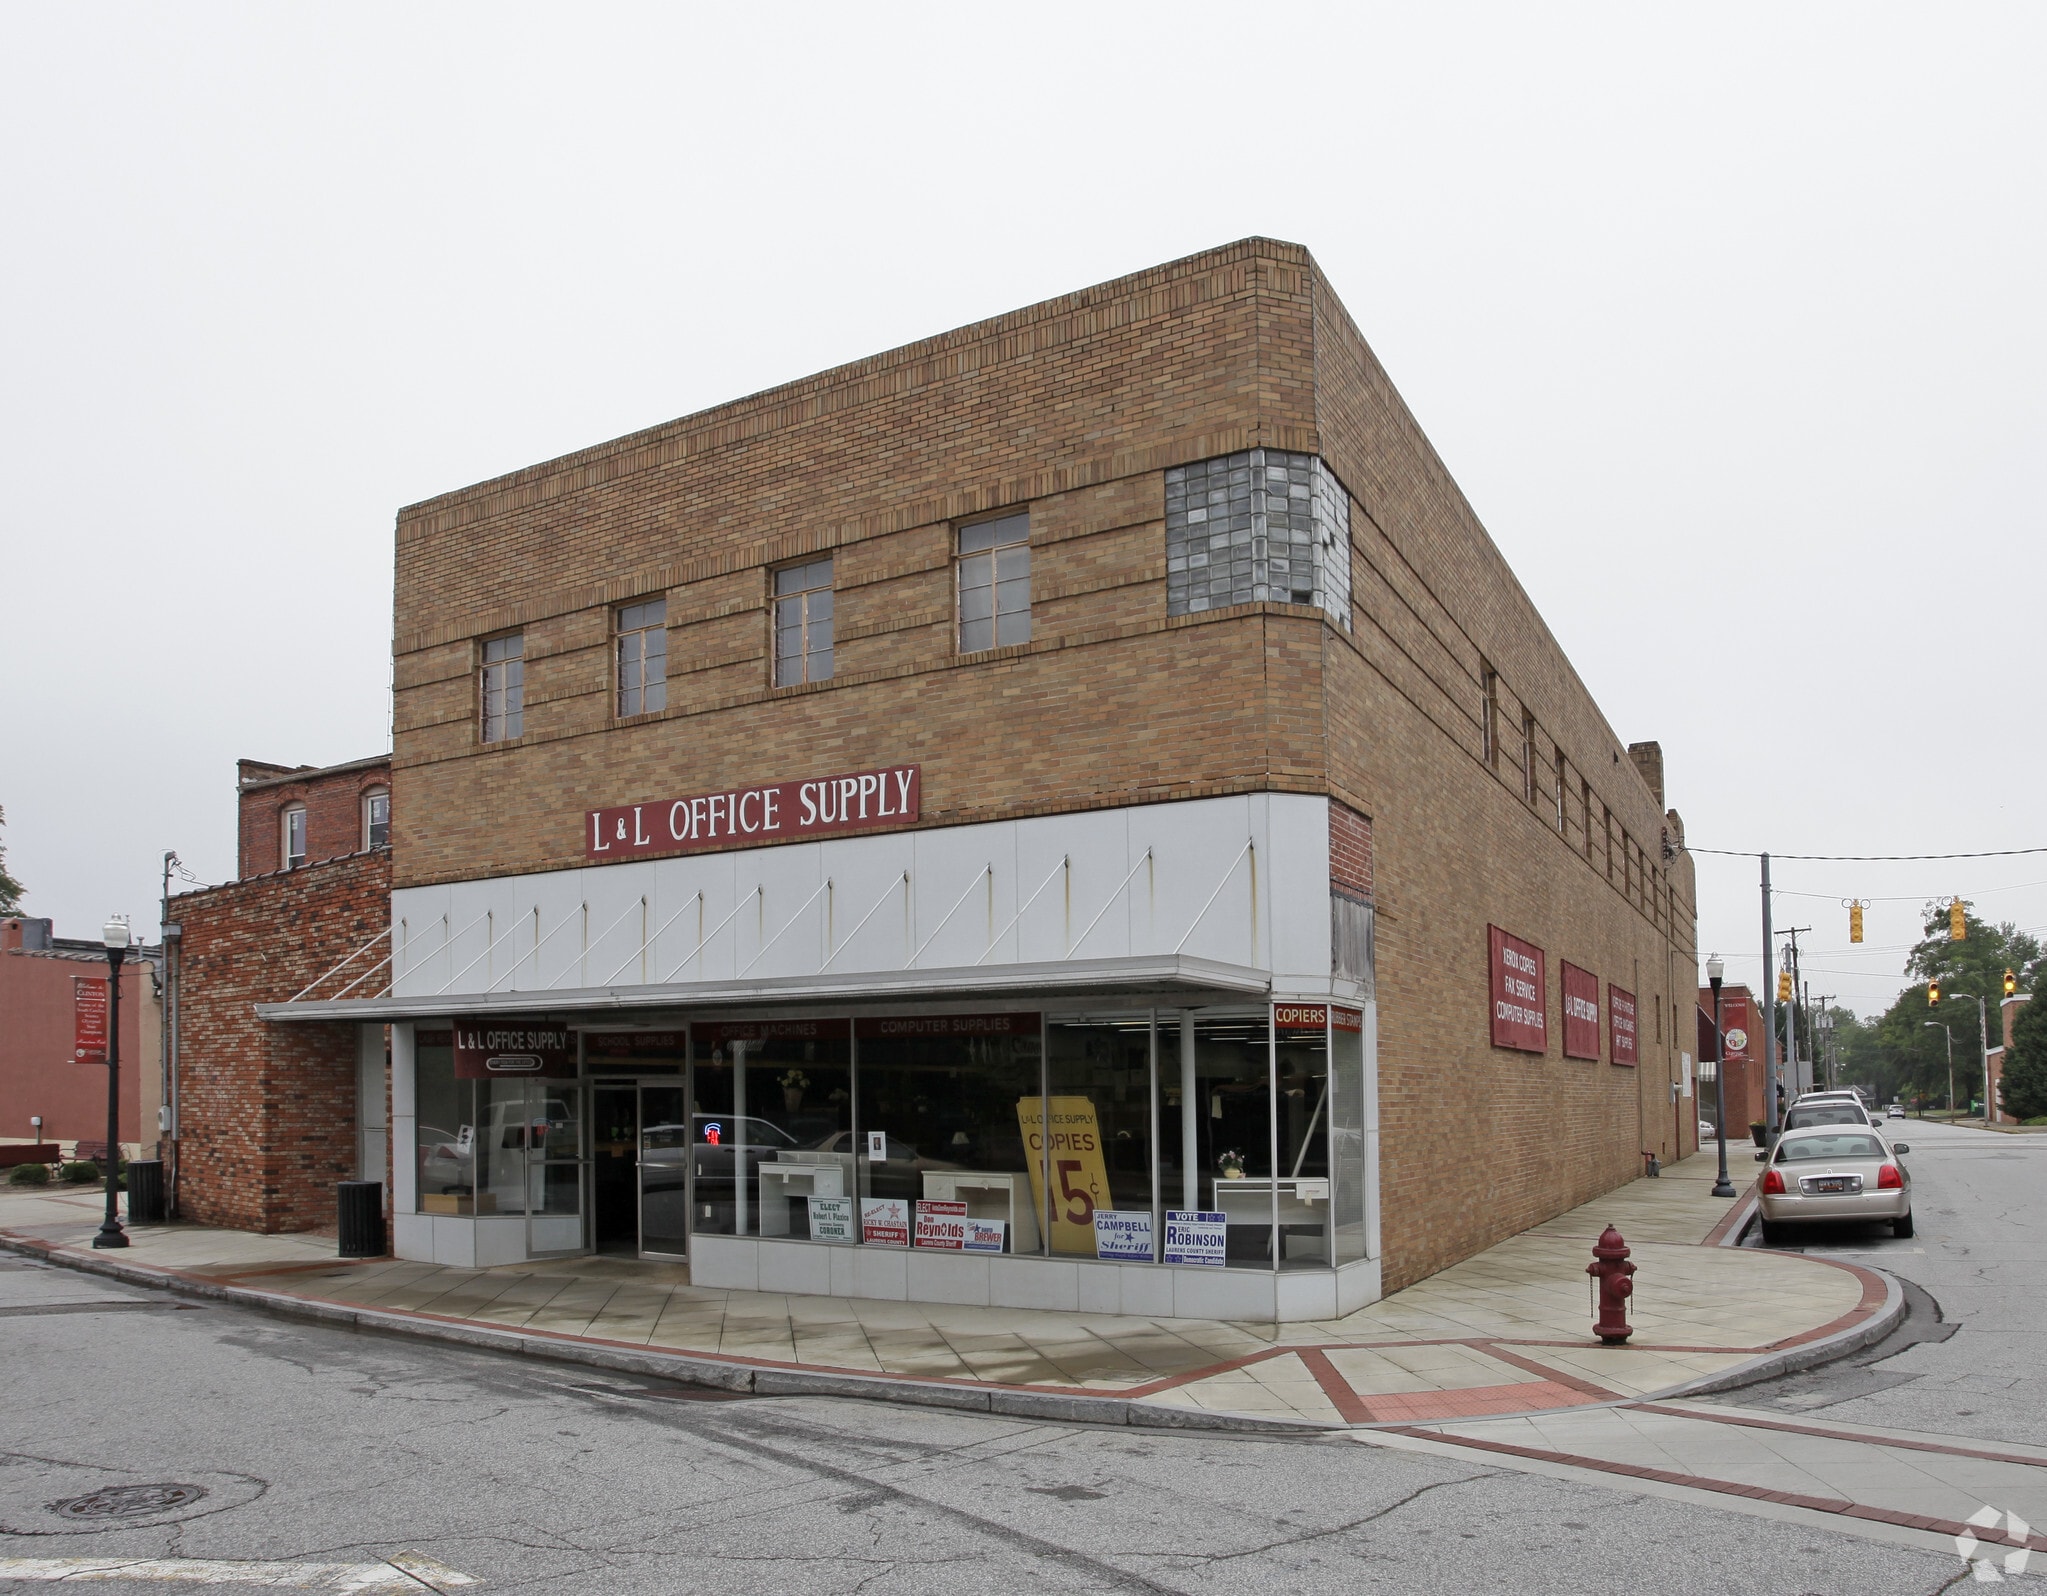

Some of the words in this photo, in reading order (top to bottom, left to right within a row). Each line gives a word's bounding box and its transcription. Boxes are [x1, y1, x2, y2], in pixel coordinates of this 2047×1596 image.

[592, 813, 610, 851] L
[616, 817, 626, 840] &
[633, 807, 650, 846] L
[669, 788, 781, 841] OFFICE
[799, 769, 914, 826] SUPPLY
[1503, 946, 1519, 970] XEROX
[1519, 955, 1536, 976] COPIES
[1505, 976, 1515, 995] FAX
[1516, 979, 1536, 1001] SERVICE
[1497, 1000, 1523, 1024] COMPUTER
[1524, 1008, 1544, 1029] SUPPLIES
[1573, 996, 1586, 1020] OFFICE
[1276, 1008, 1325, 1023] COPIERS
[1331, 1011, 1346, 1025] RUBBER
[1346, 1013, 1362, 1028] STAMPS
[721, 1025, 755, 1037] OFFICE
[760, 1023, 817, 1036] MACHINES
[881, 1019, 948, 1033] COMPUTER
[952, 1018, 1011, 1031] SUPPLIES
[458, 1030, 465, 1049] L
[468, 1033, 476, 1050] &
[477, 1031, 485, 1049] L
[487, 1031, 525, 1050] OFFICE
[527, 1031, 567, 1050] SUPPLY
[597, 1036, 630, 1047] SCHOOL
[635, 1035, 675, 1047] SUPPLIES
[1037, 1115, 1064, 1124] OICE
[1065, 1114, 1094, 1124] SUPPLY
[1029, 1133, 1095, 1151] COPIES
[820, 1203, 840, 1212] ELECT
[864, 1204, 885, 1218] RE-ELECT
[917, 1203, 931, 1213] ELECT
[864, 1219, 877, 1227] RICKY
[884, 1220, 907, 1228] CHASTAIN
[924, 1215, 934, 1223] Don
[1175, 1213, 1199, 1221] VOTE
[820, 1227, 845, 1236] CORONER
[1097, 1220, 1150, 1232] CAMPBELL
[873, 1230, 899, 1238] SHERIFF
[974, 1232, 1002, 1243] BREWER
[1166, 1226, 1225, 1247] ROBINSON
[1101, 1241, 1151, 1254] Sheriff
